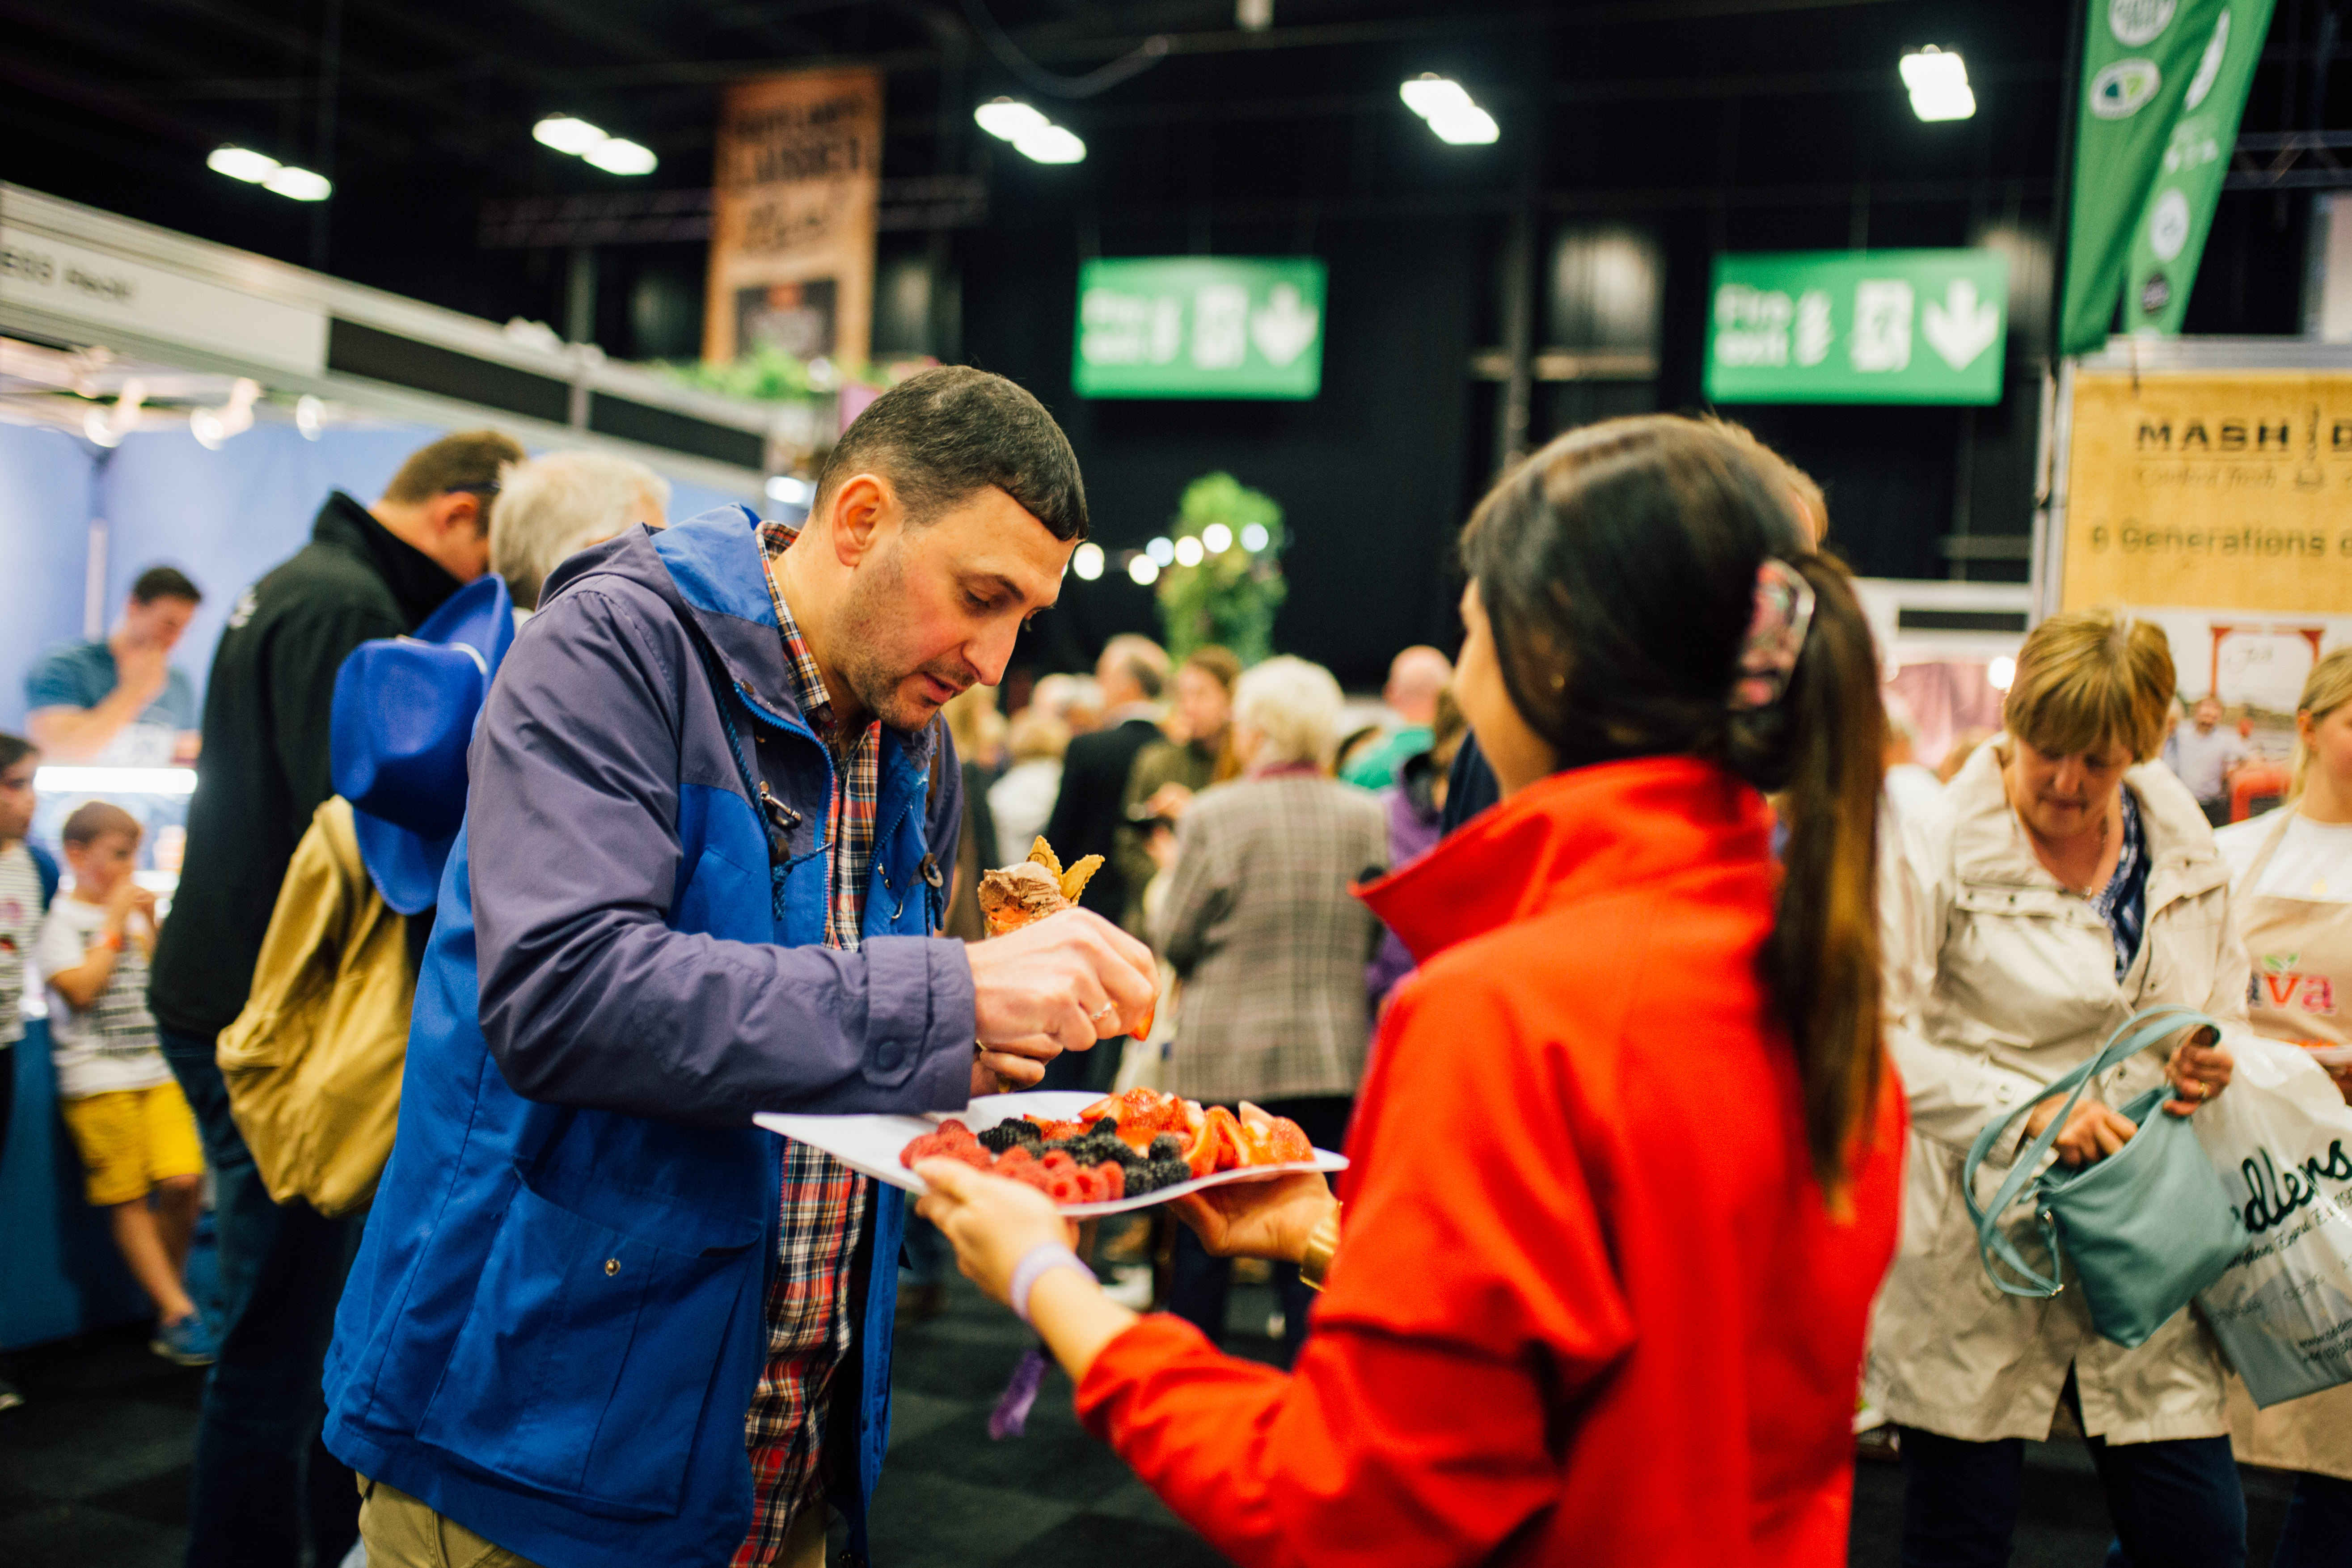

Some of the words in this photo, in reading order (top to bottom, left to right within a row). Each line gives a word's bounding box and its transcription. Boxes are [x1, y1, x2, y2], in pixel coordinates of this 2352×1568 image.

[2138, 421, 2289, 449] MASH
[2121, 519, 2325, 555] Generations
[2231, 1138, 2352, 1233] dlers
